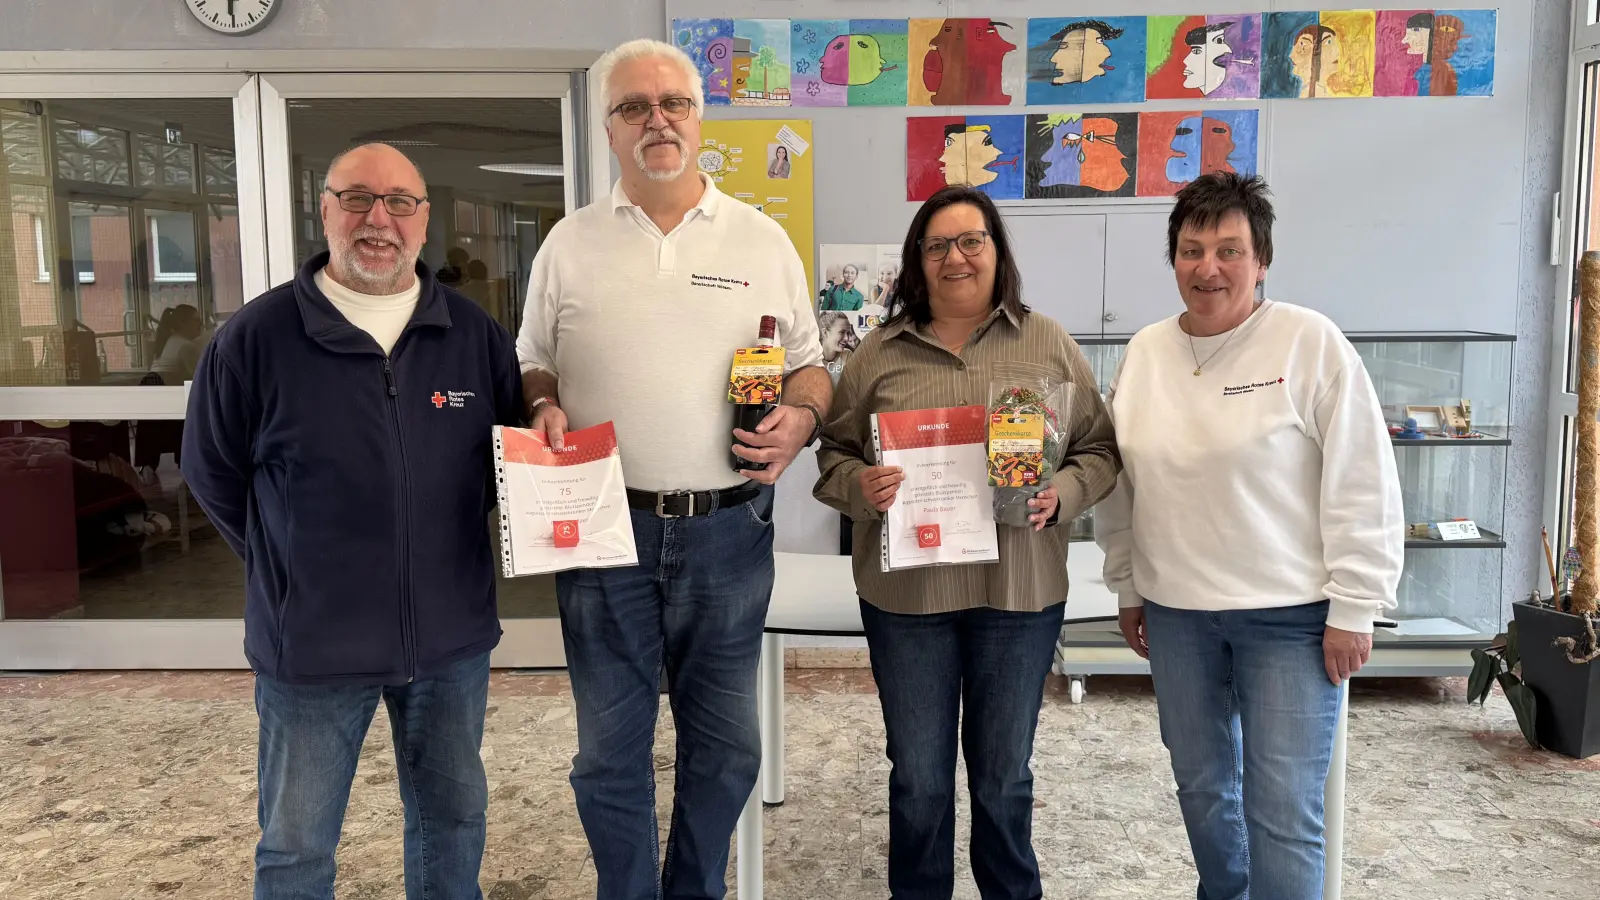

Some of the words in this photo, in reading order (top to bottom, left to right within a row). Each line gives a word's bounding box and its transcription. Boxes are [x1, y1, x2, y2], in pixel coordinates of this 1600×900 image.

[917, 423, 950, 431] URKUNDE
[542, 445, 578, 453] URNDE
[931, 471, 943, 480] 50
[559, 487, 572, 496] 75
[563, 525, 570, 534] 75
[924, 532, 934, 540] 50
